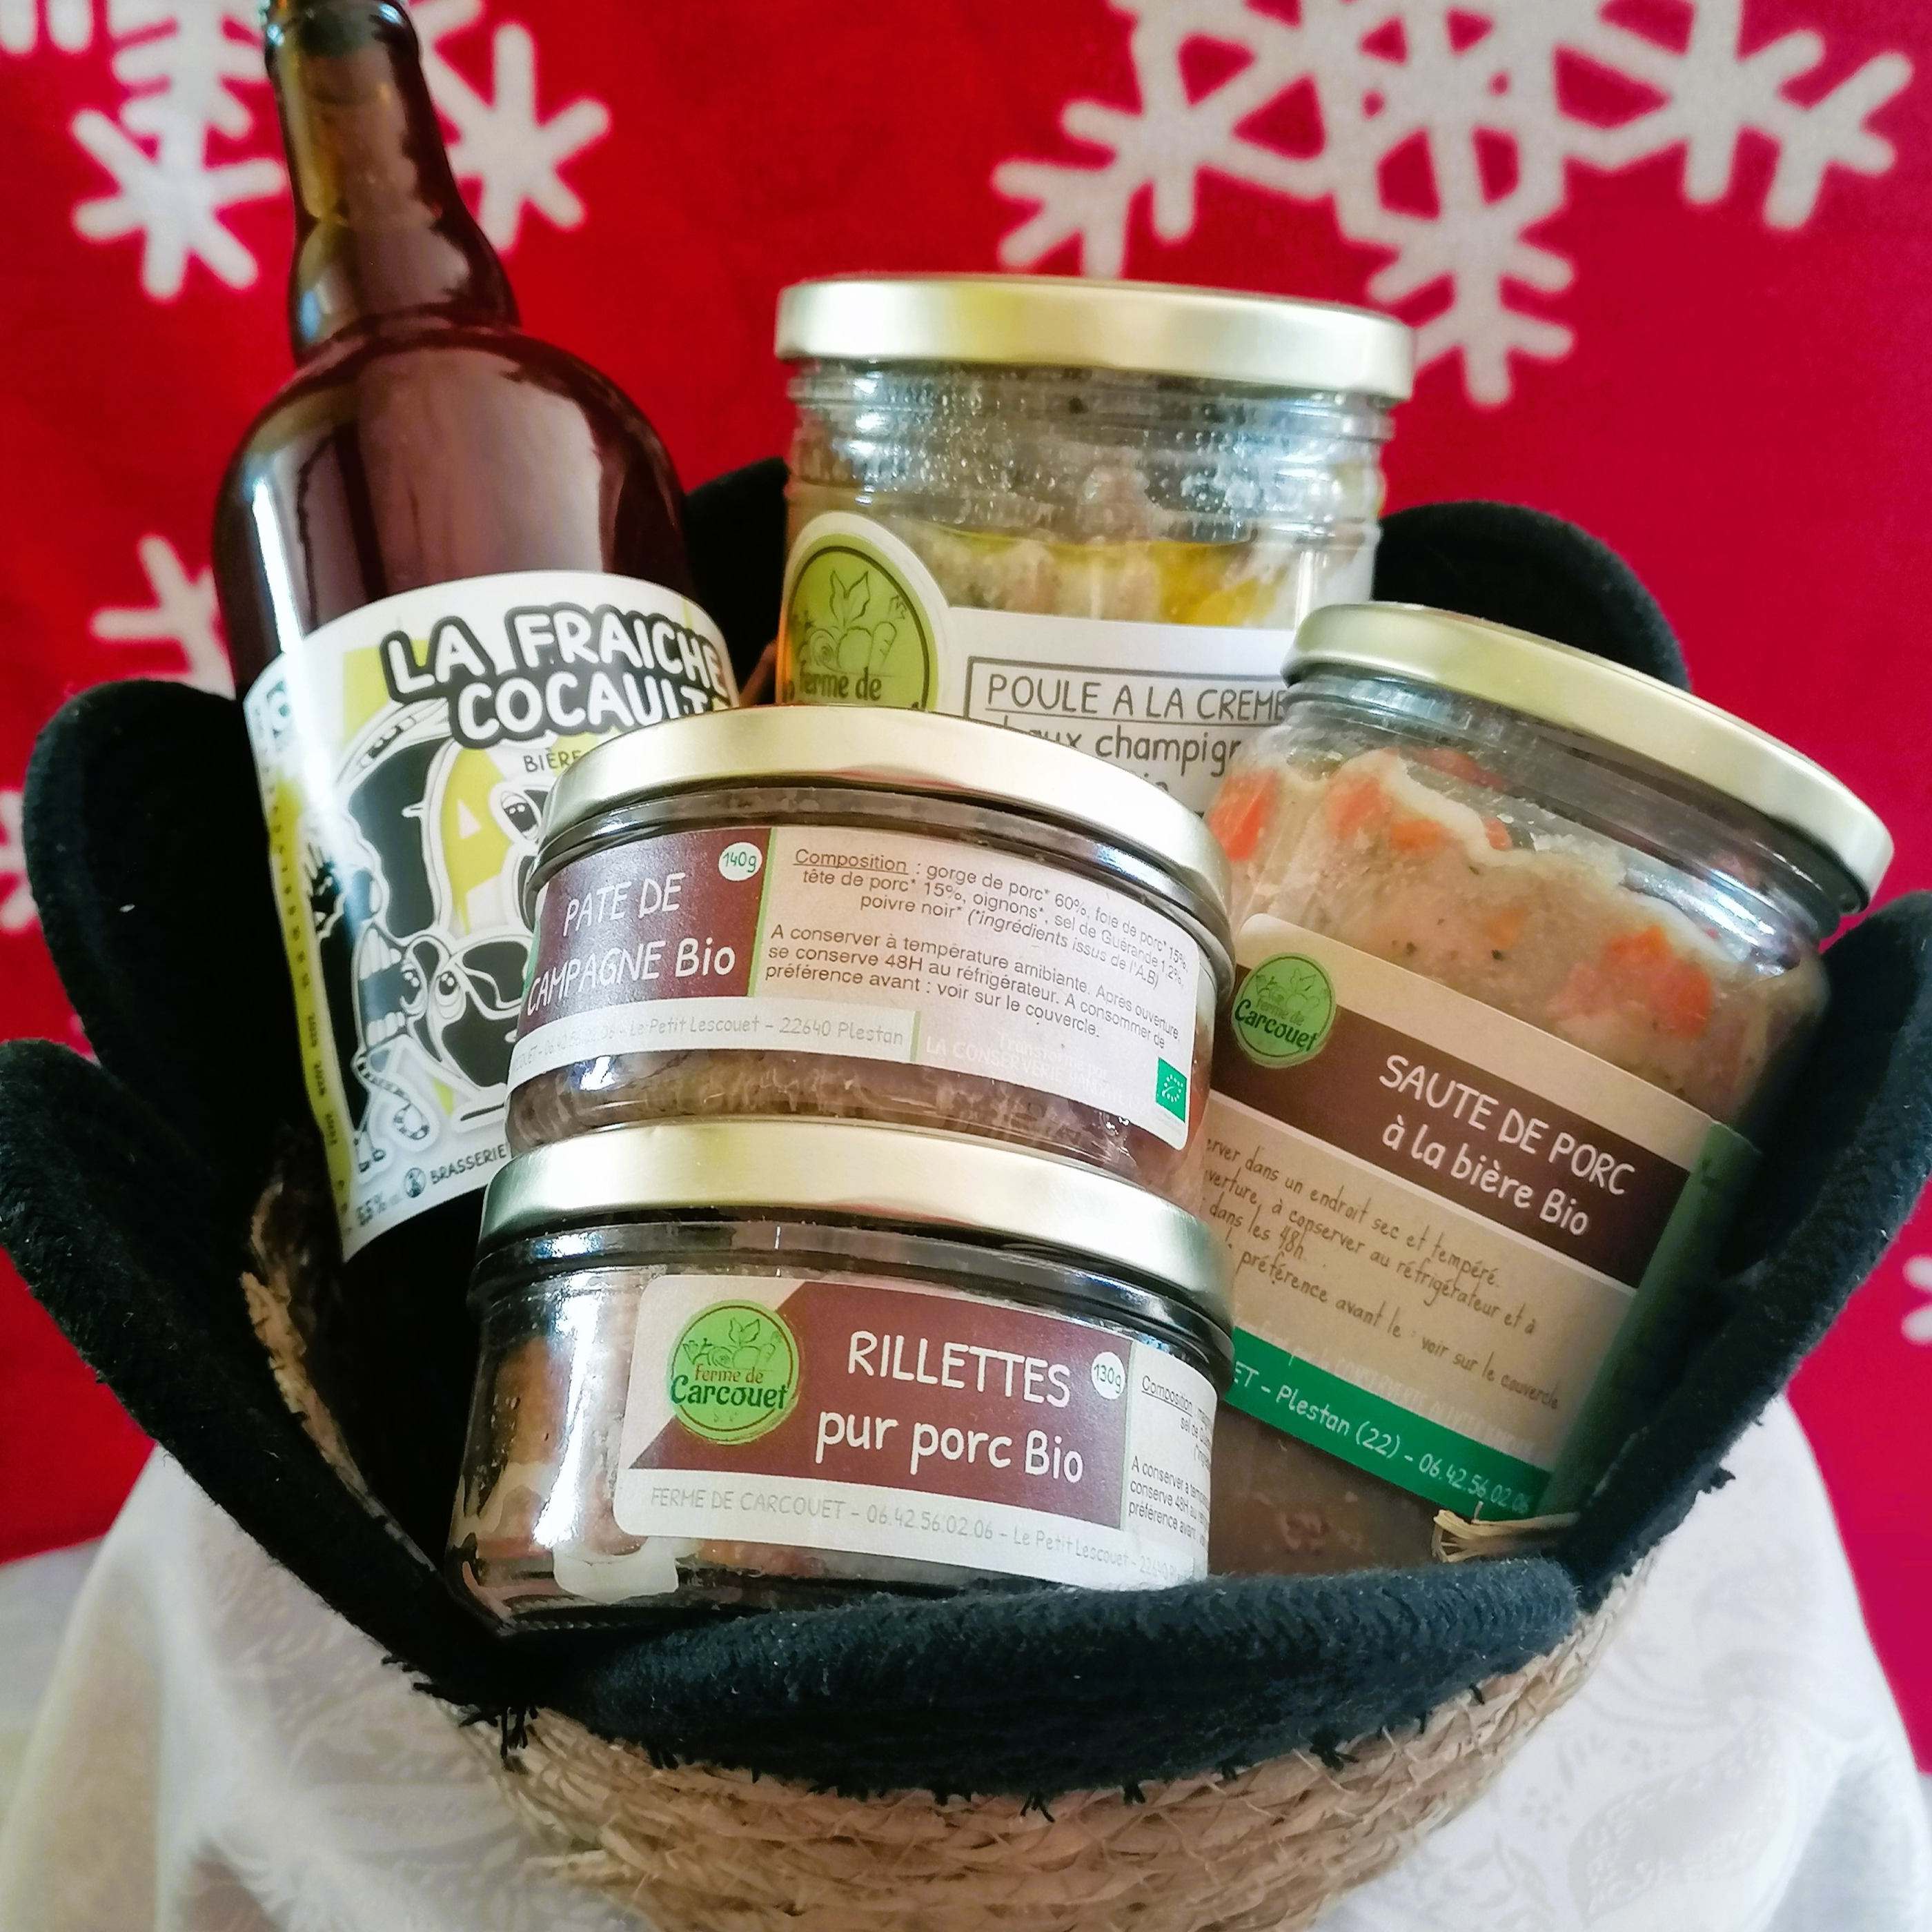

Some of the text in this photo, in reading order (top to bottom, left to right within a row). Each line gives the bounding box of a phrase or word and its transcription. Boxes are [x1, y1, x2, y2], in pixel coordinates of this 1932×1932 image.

[382, 603, 729, 702] LA FRAICHE
[855, 666, 883, 701] de
[988, 673, 1288, 721] POULE A LA CREME
[722, 851, 757, 873] 140g
[795, 849, 907, 872] Composition
[927, 865, 976, 885] gorge
[982, 874, 1003, 889] de
[1096, 907, 1118, 928] foie
[1123, 920, 1137, 936] de
[562, 872, 686, 937] PATE DE
[803, 869, 835, 885] tête
[841, 871, 863, 887] de
[925, 882, 966, 904] 15%,
[1054, 915, 1076, 931] sel
[1079, 922, 1096, 938] de
[1101, 929, 1159, 967] Guérande
[860, 896, 916, 912] poivre
[1072, 937, 1105, 962] issus
[1111, 953, 1126, 971] de
[527, 937, 736, 1016] CAMPAGNE Bio
[765, 963, 863, 984] préférence
[869, 974, 920, 992] avant
[937, 983, 969, 1002] voir
[974, 991, 1002, 1007] sur
[1007, 995, 1021, 1012] le
[1026, 1003, 1099, 1038] couvercle.
[769, 946, 1165, 1049] se conserve 48H au réfrigérateur. A consommer de
[771, 924, 783, 939] A
[790, 928, 880, 947] conserver
[886, 933, 897, 949] à
[904, 936, 1009, 969] température
[1096, 985, 1132, 1012] Après
[649, 1018, 687, 1034] Petit
[690, 1015, 760, 1033] Lescouet
[779, 1017, 831, 1036] 22640
[838, 1021, 904, 1045] Plestan
[926, 1036, 946, 1055] LA
[1234, 998, 1319, 1052] Carcouet
[1291, 1009, 1306, 1027] de
[1379, 1054, 1636, 1195] SAUTE DE PORC
[429, 1143, 507, 1184] BRASSERIE
[1382, 1114, 1590, 1236] à la bière Bio
[1210, 1192, 1243, 1228] dans
[1248, 1204, 1270, 1241] les
[1245, 1145, 1279, 1181] dans
[1285, 1176, 1303, 1194] un
[1310, 1185, 1371, 1223] endroit
[1372, 1219, 1399, 1239] sec
[1406, 1225, 1430, 1251] et
[1272, 1198, 1283, 1214] à
[1289, 1209, 1365, 1253] conserver
[1370, 1252, 1390, 1268] au
[1397, 1258, 1500, 1317] réfrigérateur
[1504, 1303, 1526, 1329] et
[1524, 1318, 1537, 1335] à
[1235, 1250, 1328, 1303] préférence
[1335, 1301, 1386, 1328] avant
[1388, 1306, 1401, 1338] le
[1422, 1336, 1449, 1357] voir
[1452, 1352, 1478, 1372] sur
[1482, 1351, 1495, 1381] le
[1500, 1374, 1559, 1410] couvercle
[671, 1374, 788, 1409] Carcouet
[745, 1366, 764, 1383] de
[848, 1330, 1070, 1408] RILLETTES
[1094, 1362, 1122, 1394] 130g
[1141, 1375, 1193, 1412] Composition
[814, 1411, 1083, 1483] pur porc Bio
[1276, 1384, 1351, 1437] Plestan
[1355, 1420, 1401, 1460] (22)
[1130, 1479, 1173, 1508] conserve
[1132, 1455, 1140, 1473] A
[1142, 1464, 1184, 1490] conserver
[651, 1487, 707, 1508] FERME
[711, 1490, 734, 1510] DE
[740, 1492, 847, 1520] CARCOUET
[867, 1504, 993, 1539] 06.42.56.02.06
[1013, 1527, 1030, 1546] Le
[1036, 1529, 1072, 1552] Petit
[1075, 1539, 1129, 1566] Lescouet
[1129, 1500, 1178, 1531] préférence
